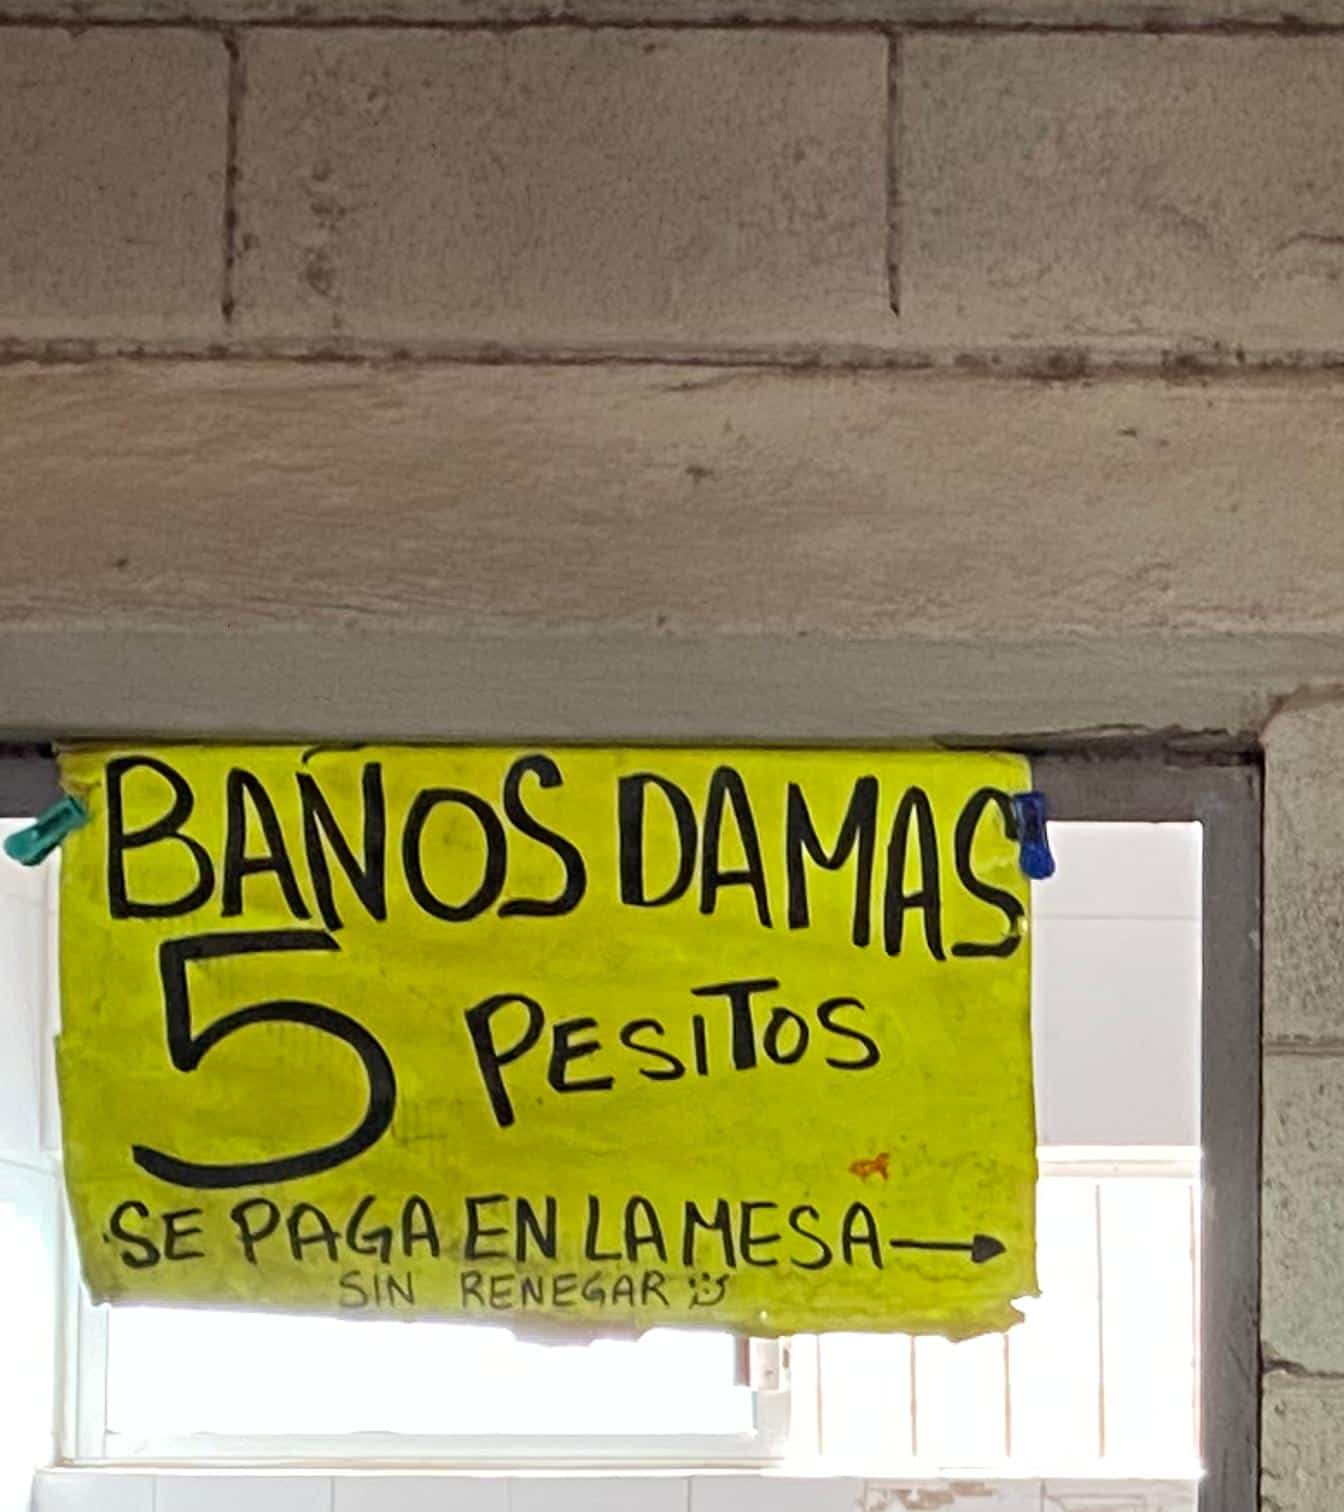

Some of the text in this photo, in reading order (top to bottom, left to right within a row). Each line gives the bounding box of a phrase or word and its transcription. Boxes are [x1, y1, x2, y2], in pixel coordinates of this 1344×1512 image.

[106, 744, 1028, 961] BAÑOS DAMAS
[131, 928, 882, 1190] 5 PESITOS
[108, 1200, 206, 1268] SE
[230, 1194, 440, 1264] PAGA
[463, 1194, 558, 1263] EN
[338, 1269, 670, 1310] SIN RENEGAR
